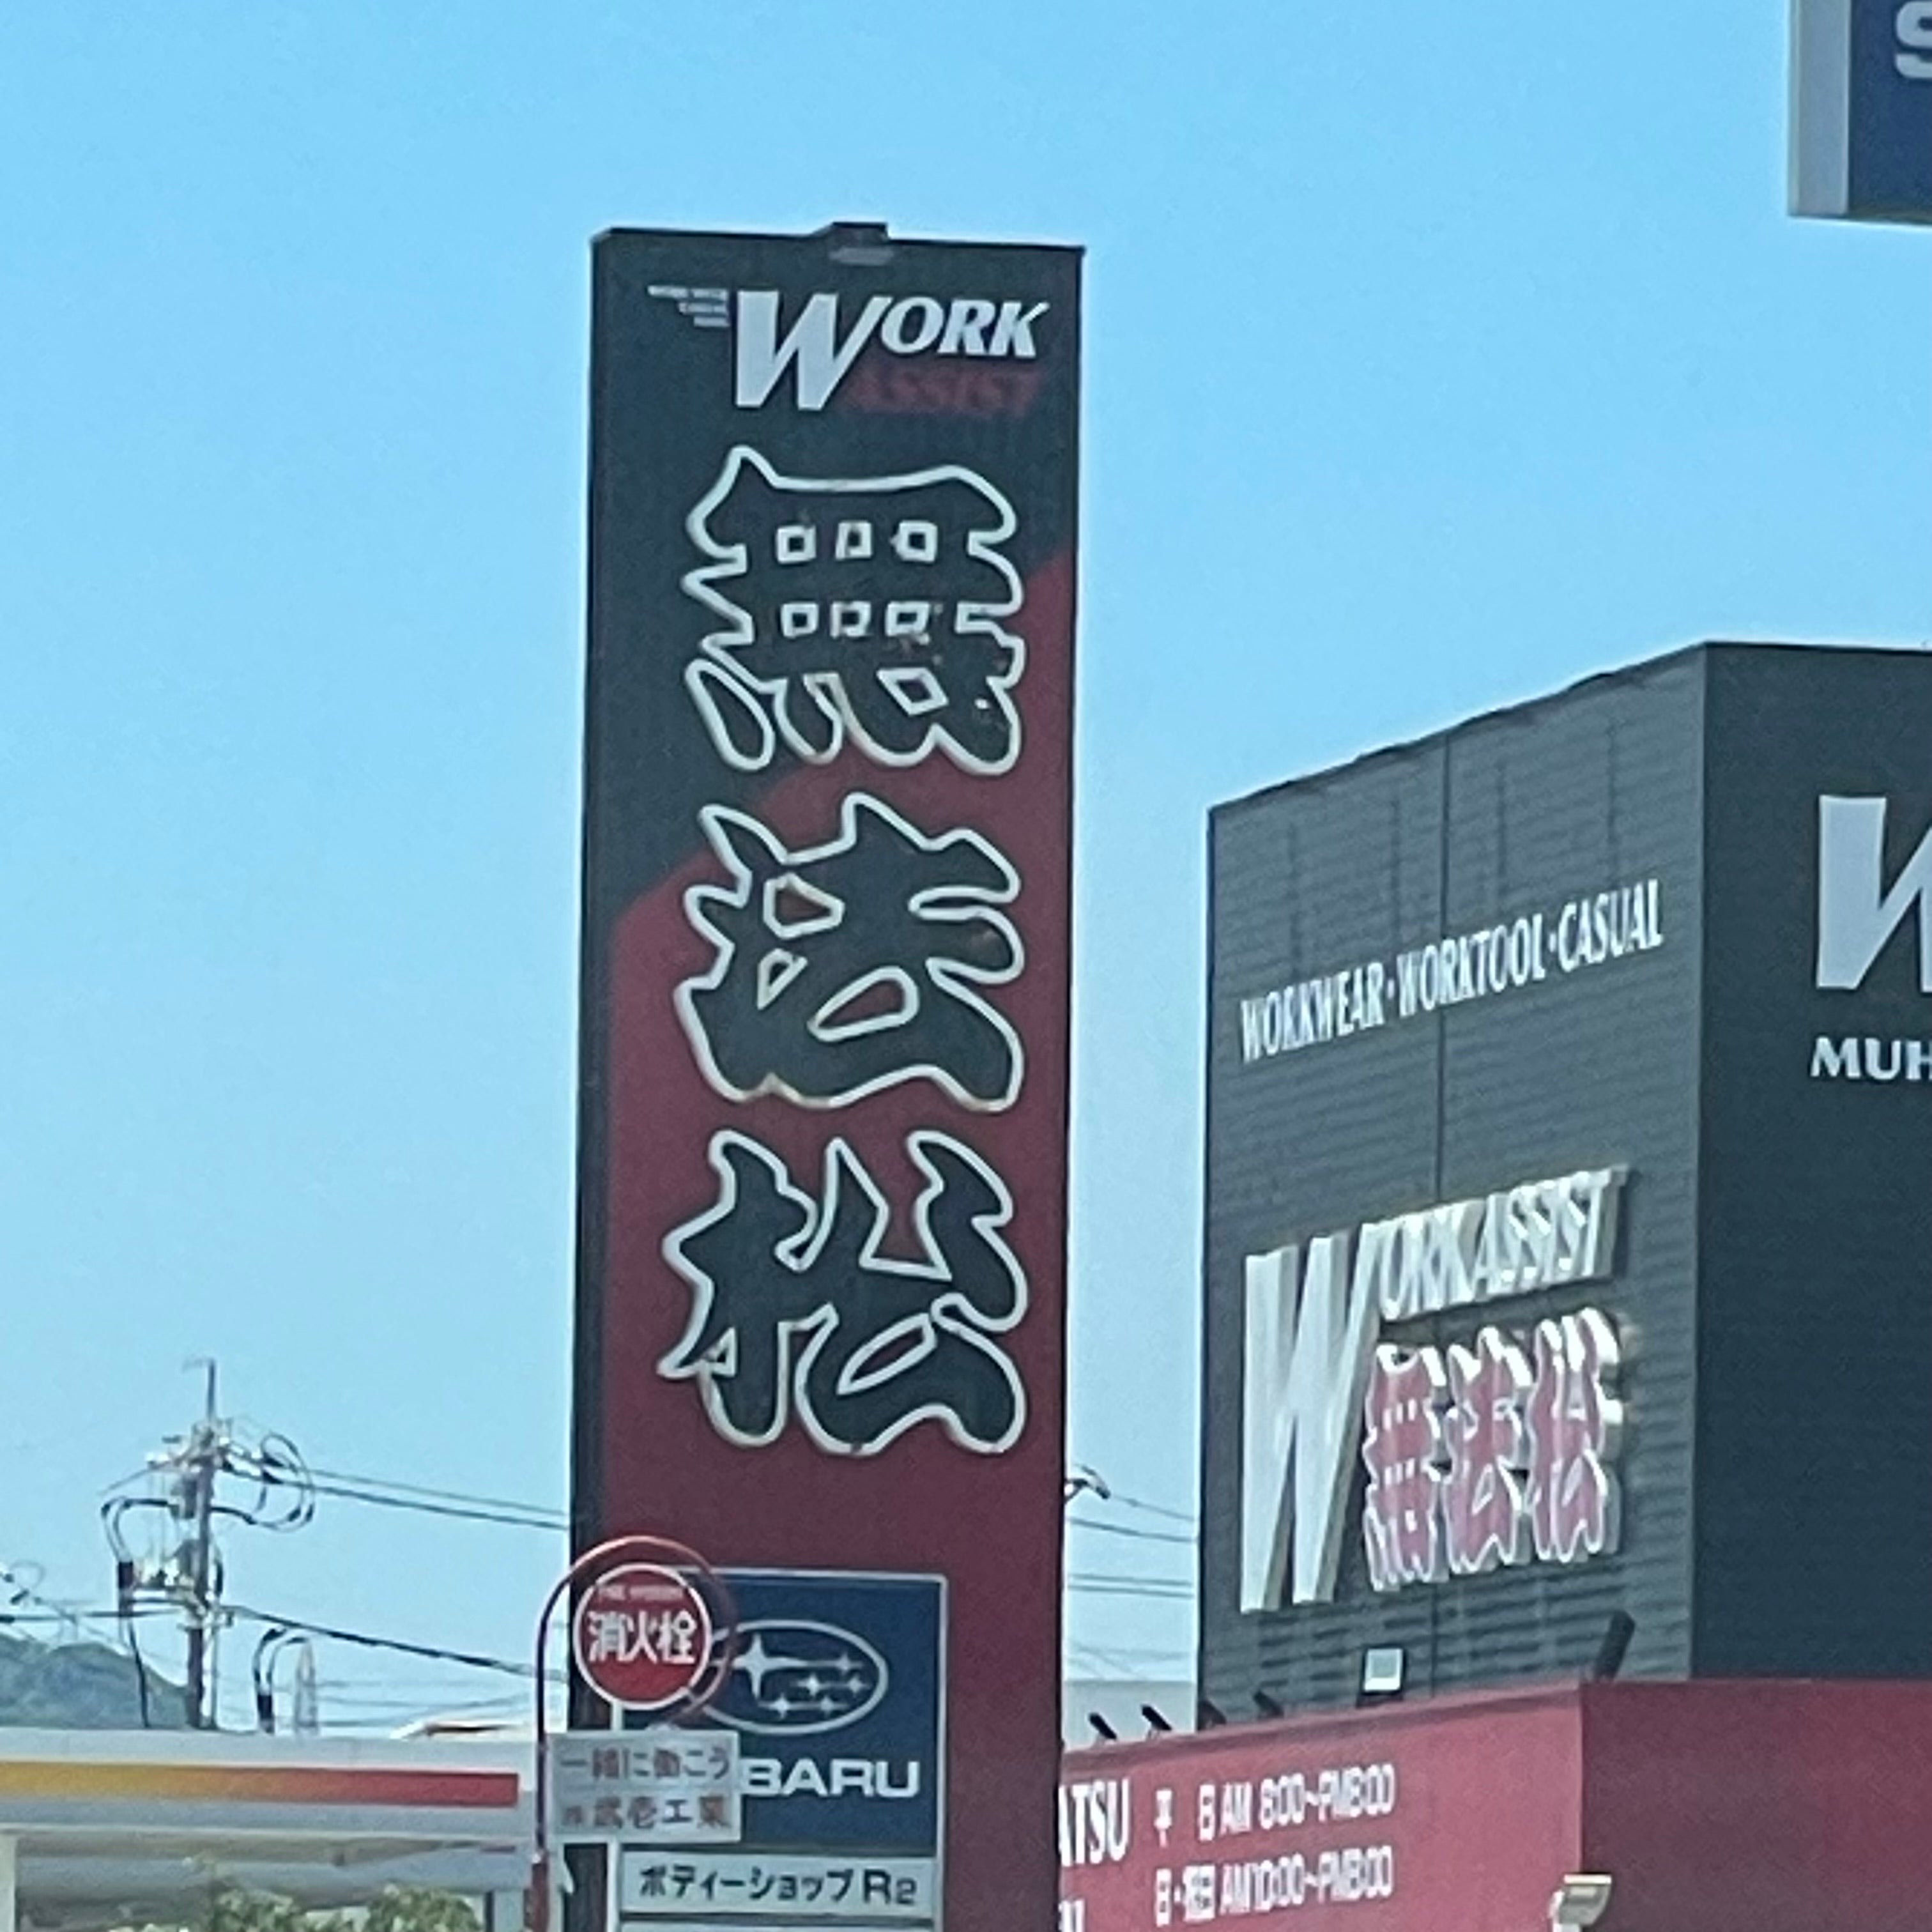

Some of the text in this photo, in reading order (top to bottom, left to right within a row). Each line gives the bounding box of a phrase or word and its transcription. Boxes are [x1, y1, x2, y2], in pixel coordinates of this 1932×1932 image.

[735, 289, 1050, 411] WORK
[1810, 1036, 1932, 1080] MUH
[587, 1611, 696, 1665] 消火栓
